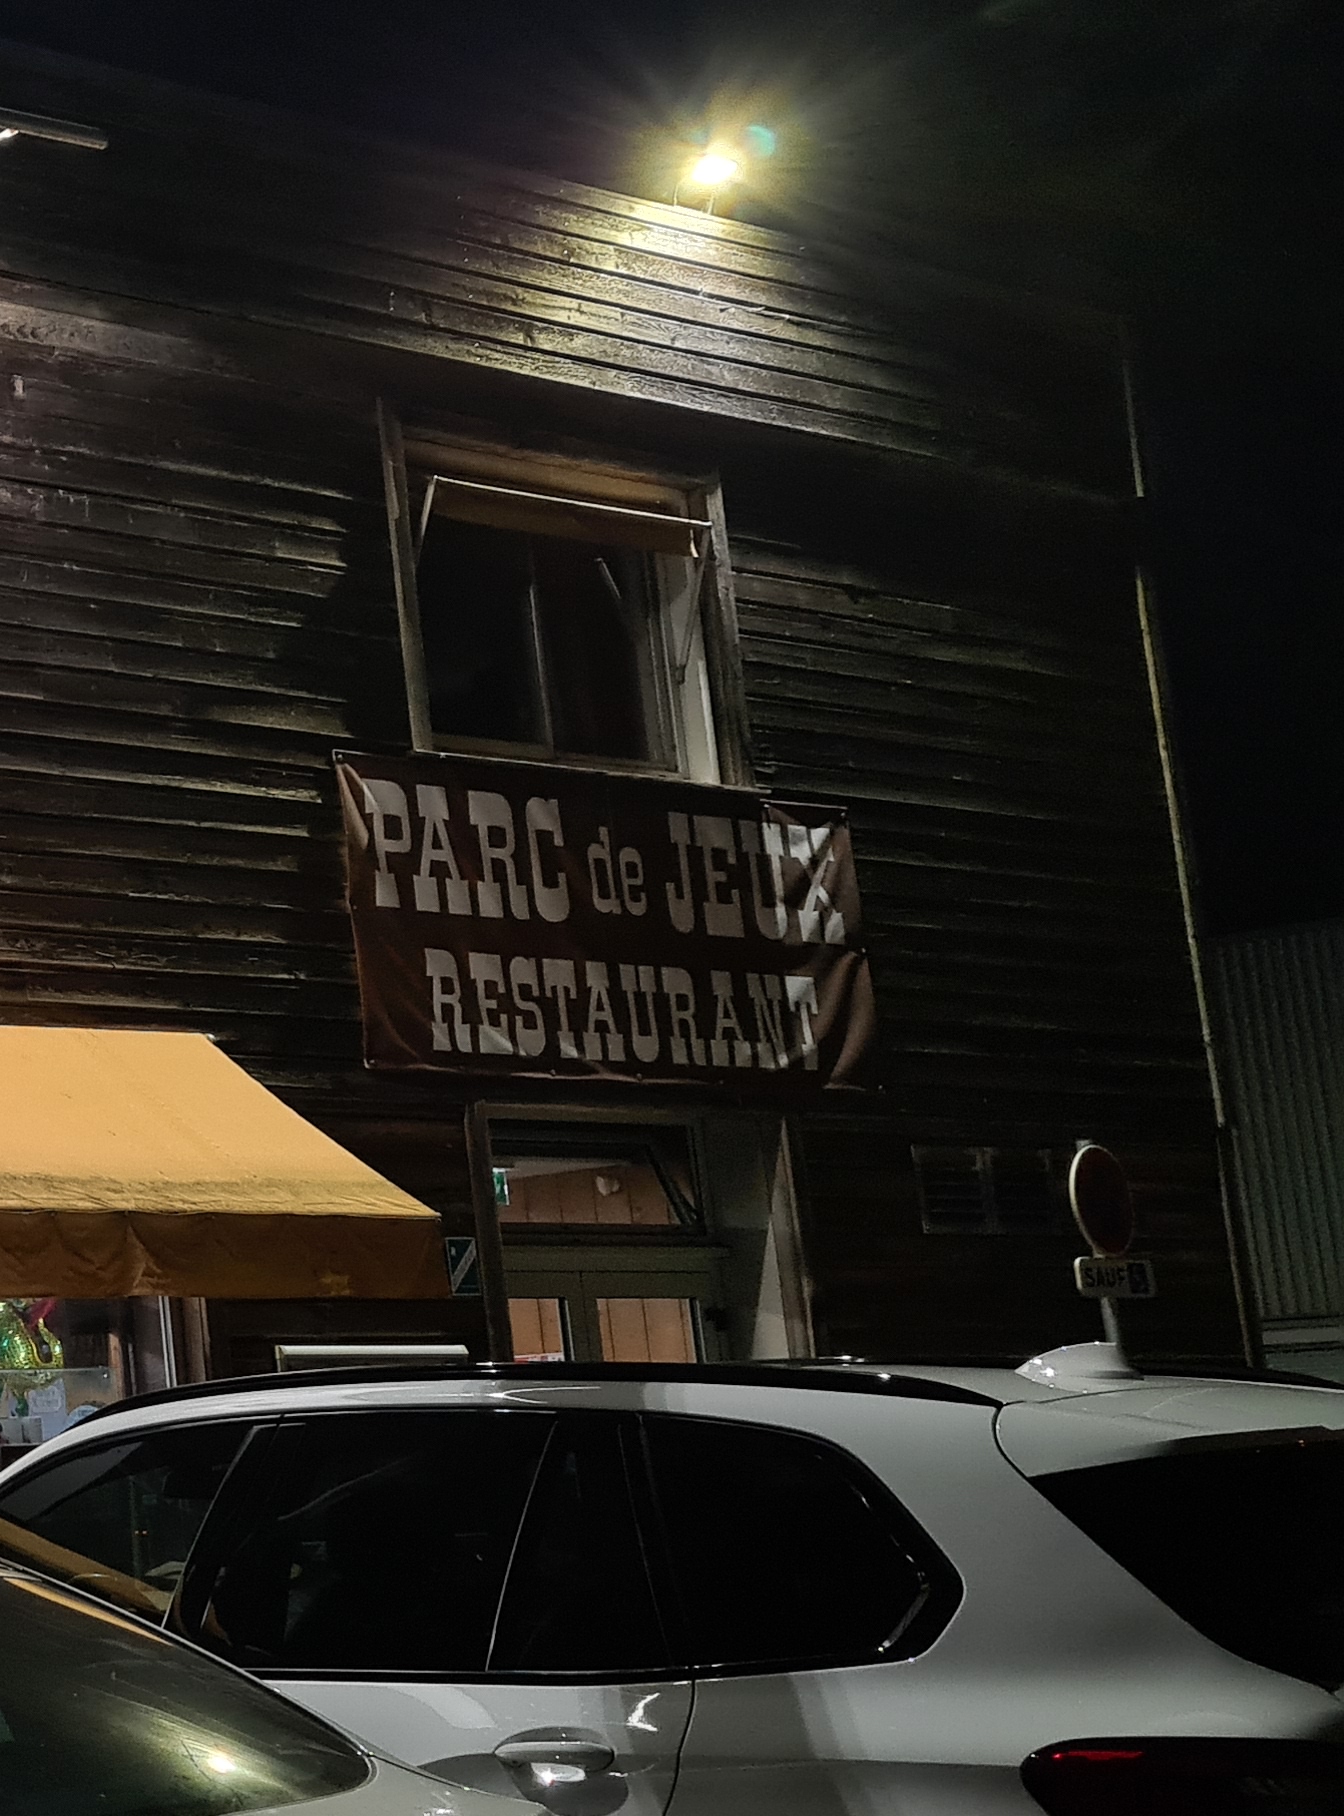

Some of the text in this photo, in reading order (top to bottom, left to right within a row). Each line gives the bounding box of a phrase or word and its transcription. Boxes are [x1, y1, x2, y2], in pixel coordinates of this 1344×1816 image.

[365, 777, 847, 945] PARC de JEUX
[425, 947, 819, 1071] RESTAURANT
[1084, 1266, 1127, 1288] SAUF
